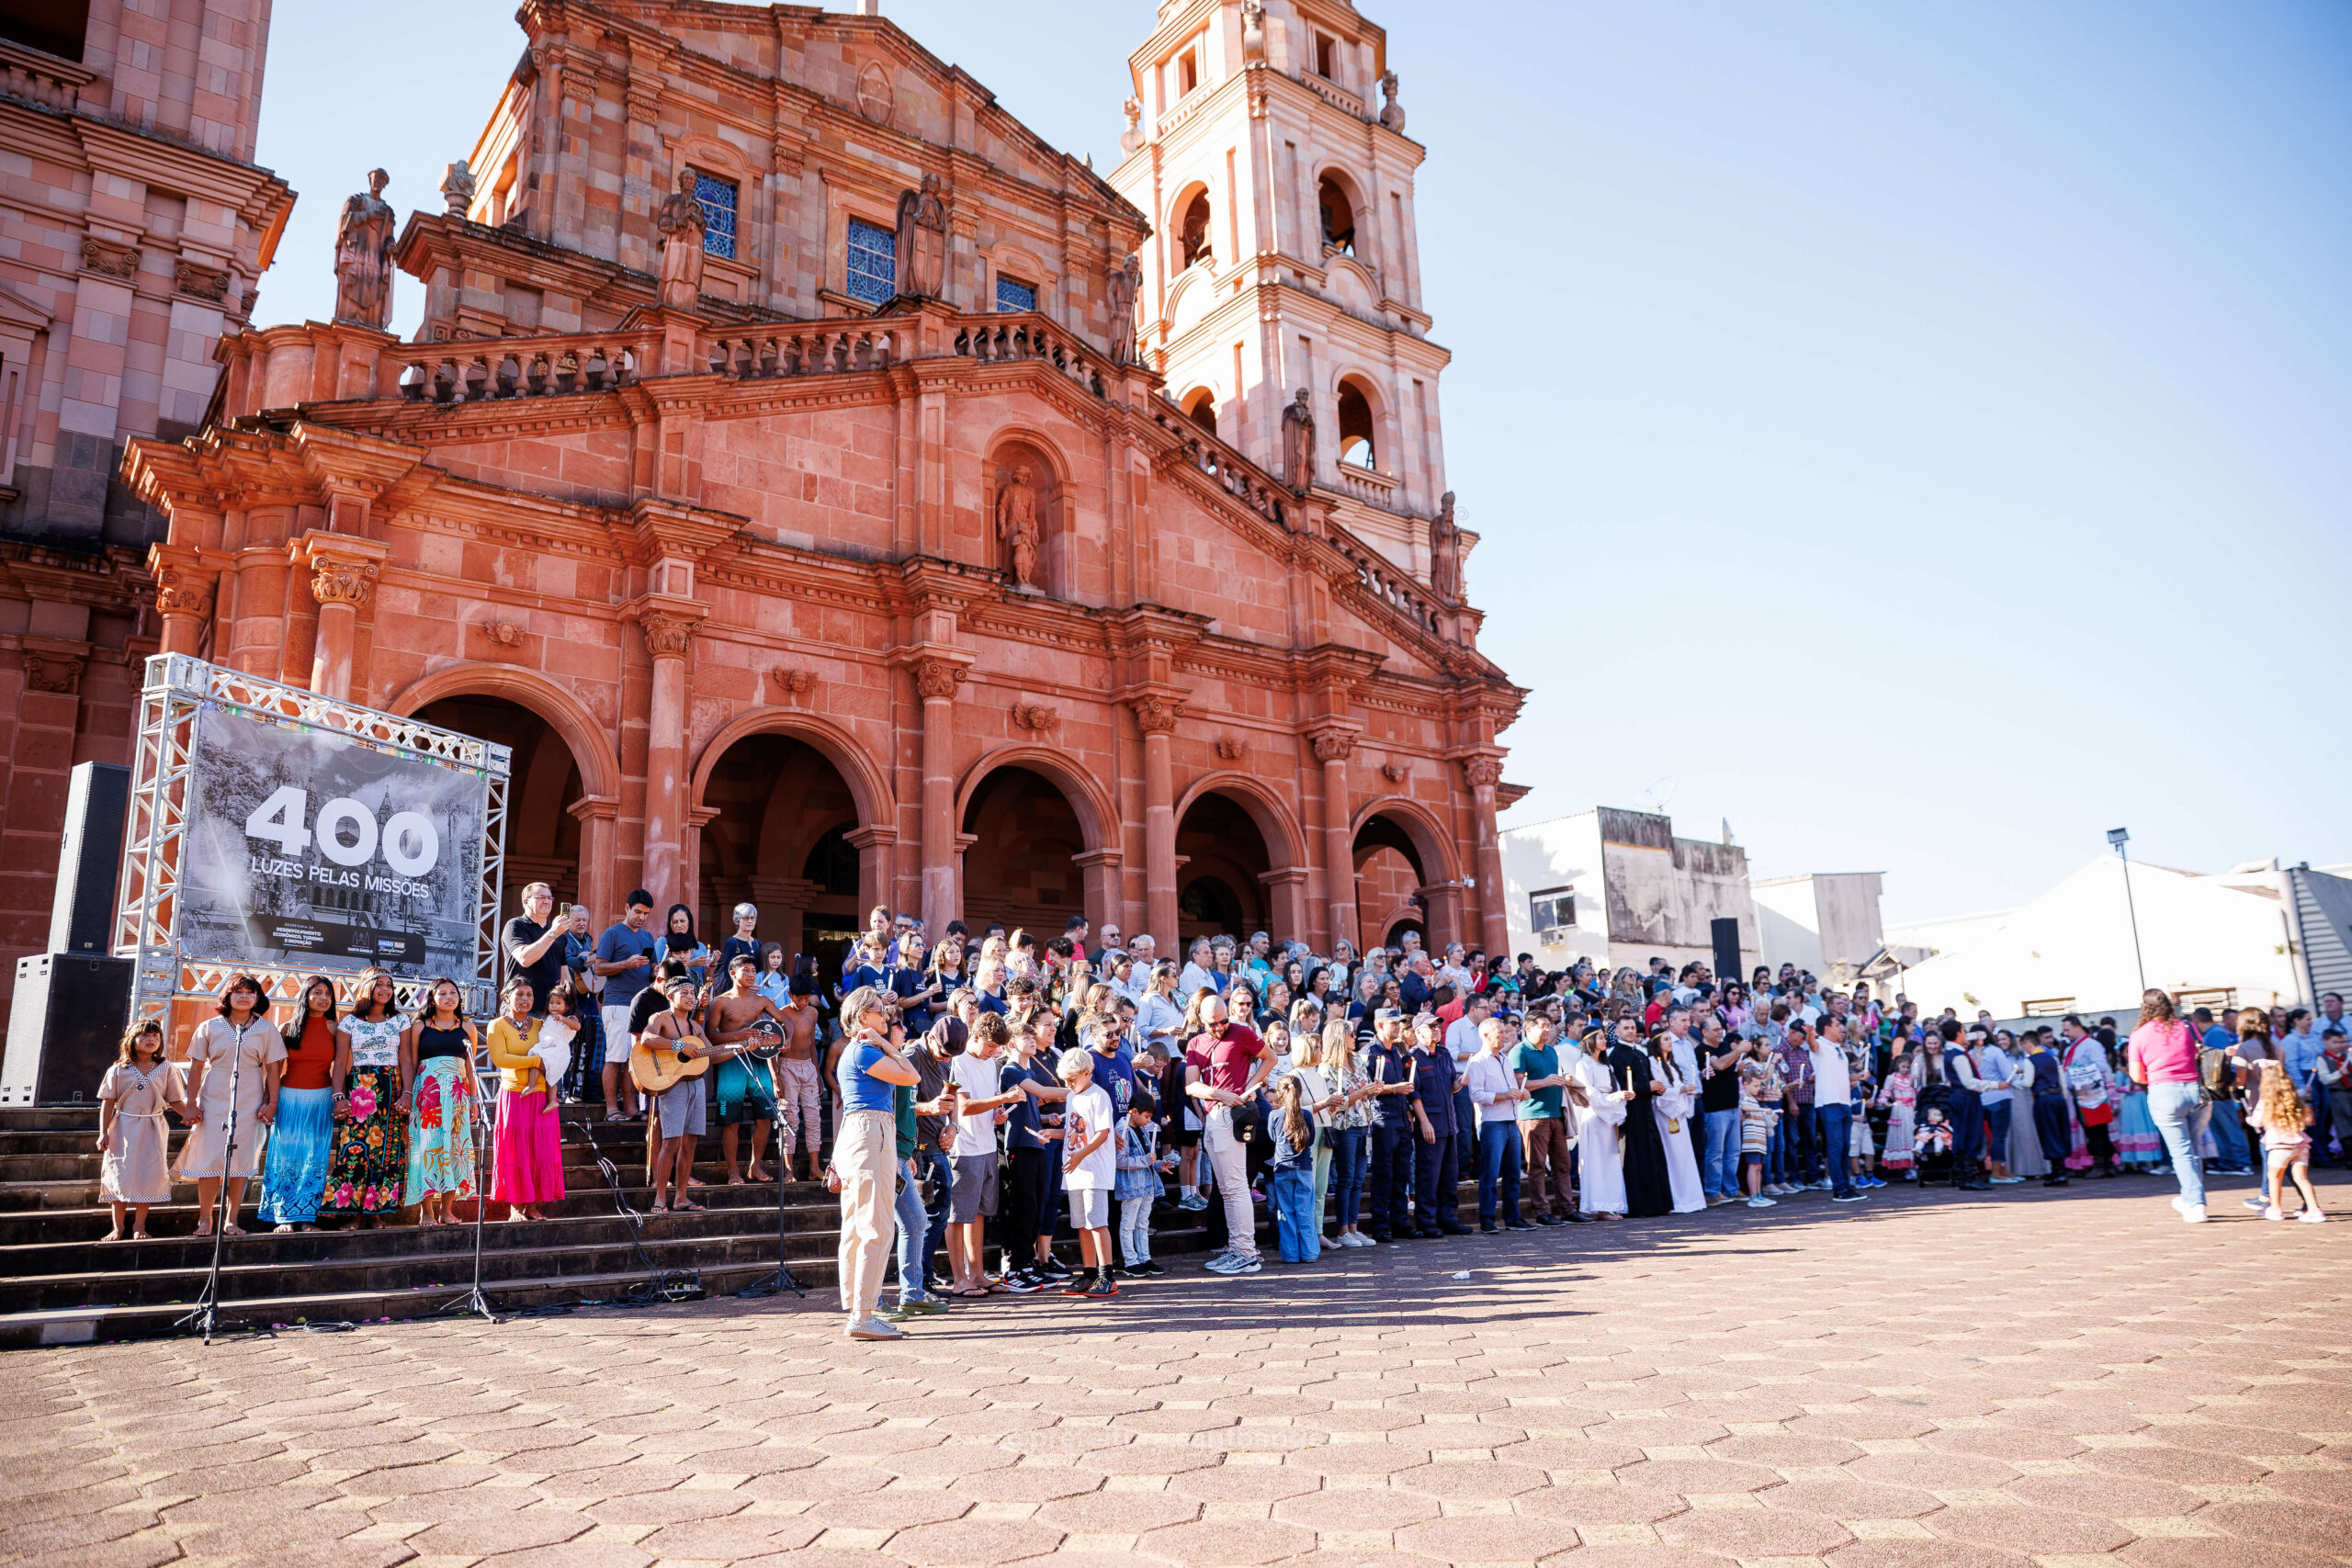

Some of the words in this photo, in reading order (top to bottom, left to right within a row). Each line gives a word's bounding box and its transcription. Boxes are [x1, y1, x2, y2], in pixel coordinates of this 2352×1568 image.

[245, 785, 439, 877] 400
[252, 856, 303, 879] LUZES
[309, 865, 360, 888] PELAS
[365, 874, 430, 898] MISSÕES
[276, 927, 322, 937] DESENVOLVIMENTO
